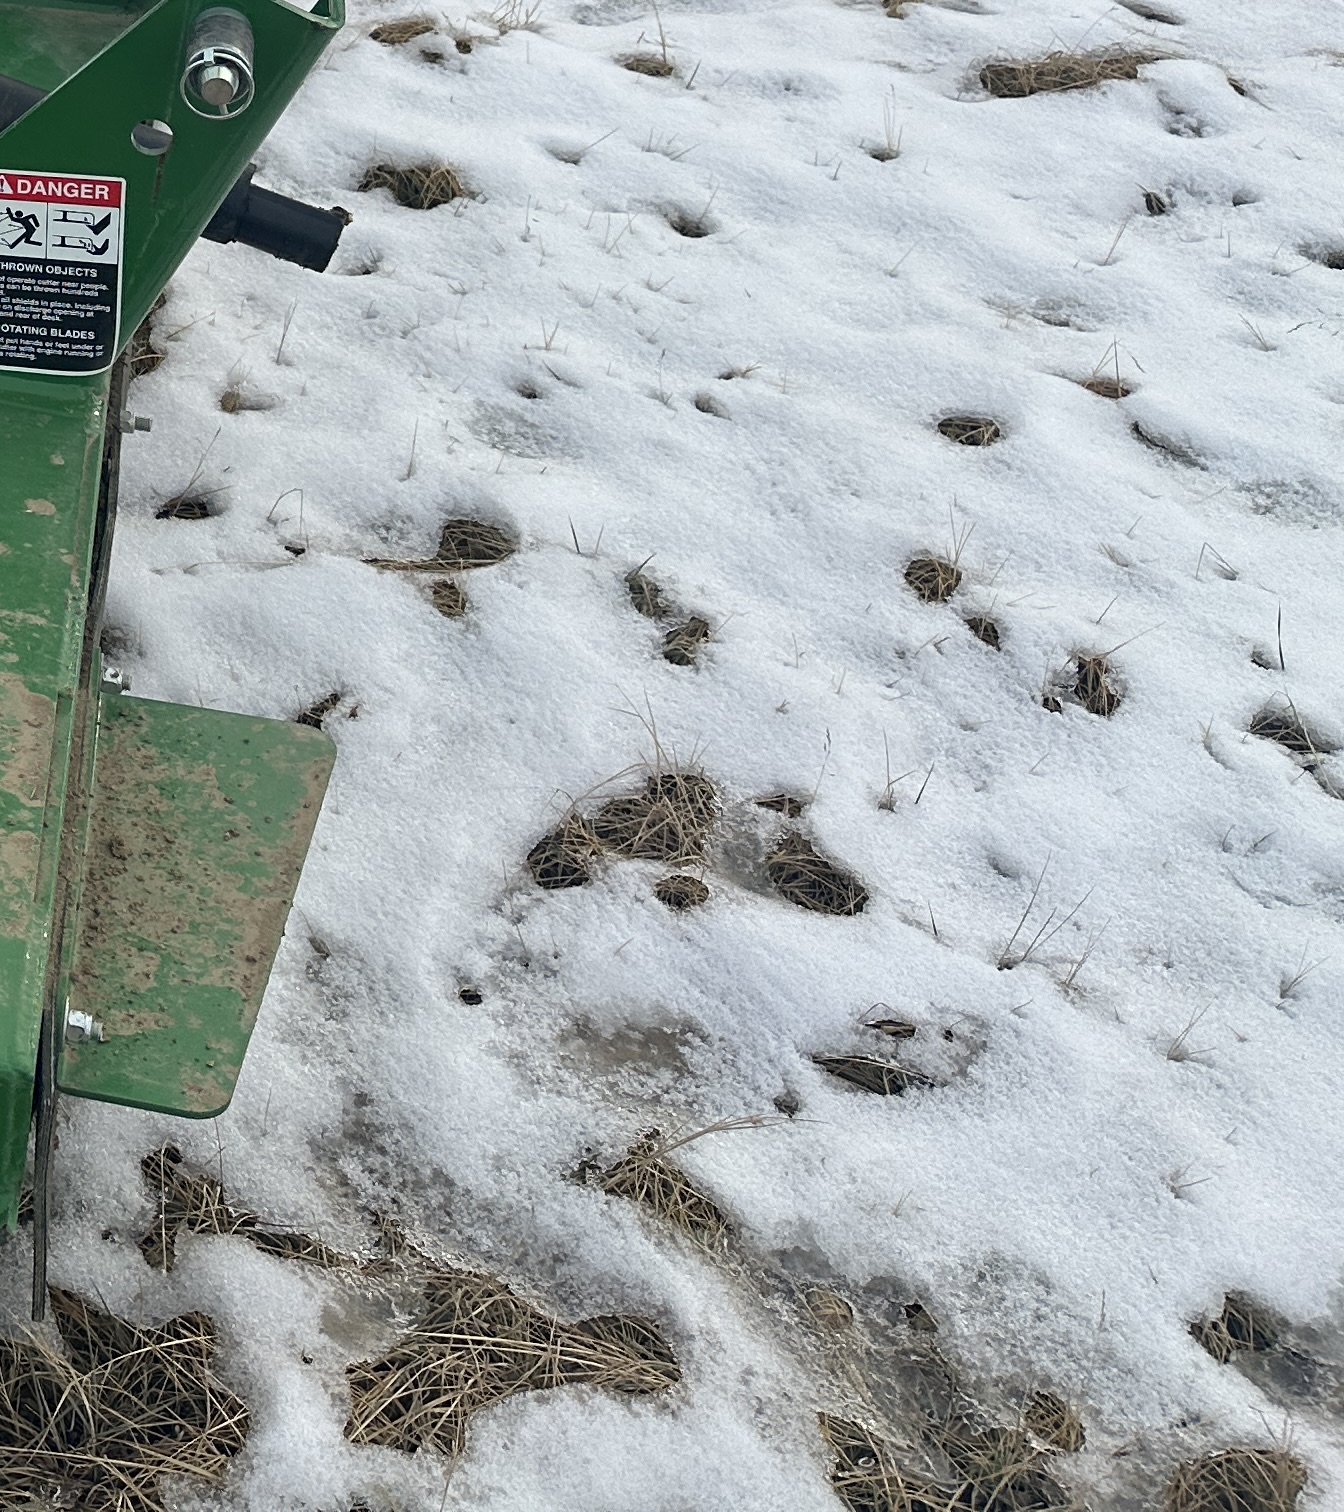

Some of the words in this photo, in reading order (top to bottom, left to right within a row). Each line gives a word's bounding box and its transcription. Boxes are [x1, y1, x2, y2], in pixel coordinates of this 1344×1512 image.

[16, 178, 110, 200] DANGER
[45, 265, 98, 278] OBJECTS
[50, 327, 96, 340] BLADES
